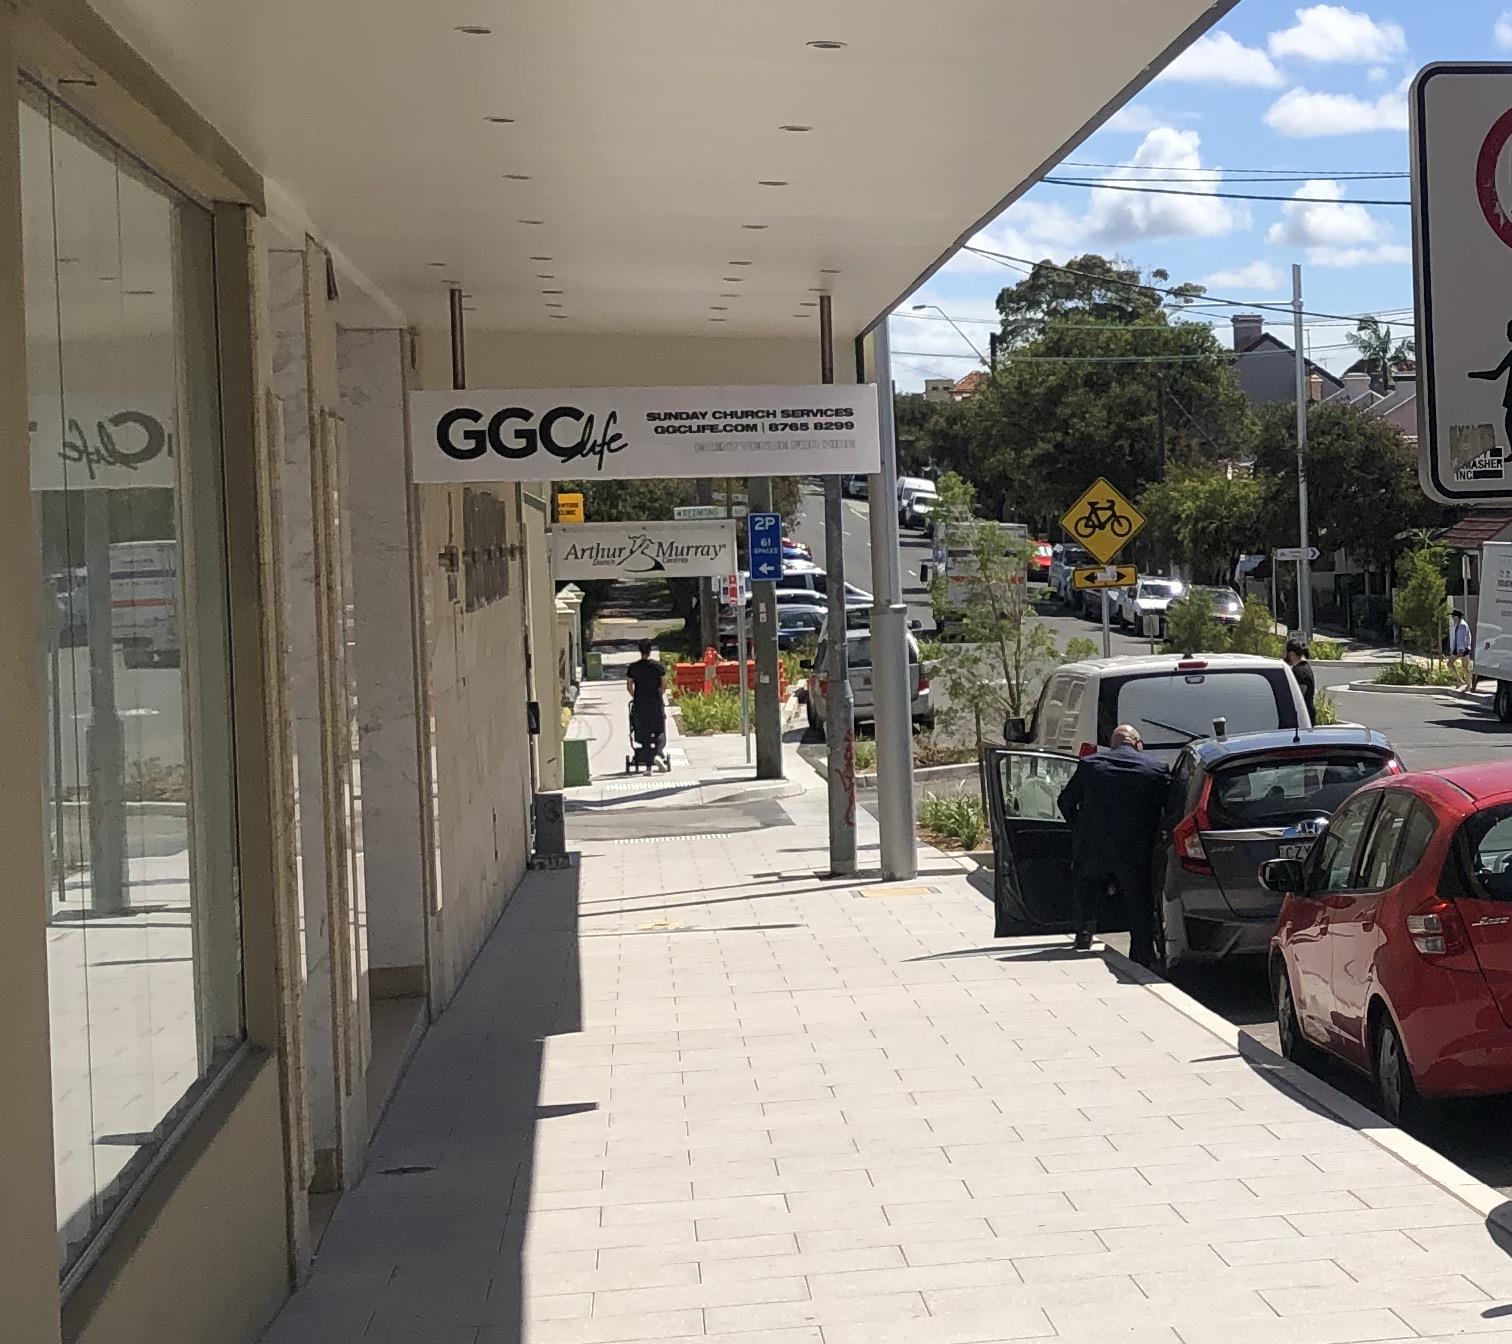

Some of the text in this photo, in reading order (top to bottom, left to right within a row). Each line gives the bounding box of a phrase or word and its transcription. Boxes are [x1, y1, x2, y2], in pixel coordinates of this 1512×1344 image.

[646, 407, 855, 422] SUNDAY CHURCH SERVICES
[653, 422, 759, 435] GGCLIFE.COM
[768, 421, 810, 433] 8765
[1456, 470, 1473, 481] INC
[754, 516, 776, 531] 2P
[563, 542, 628, 561] Arthur
